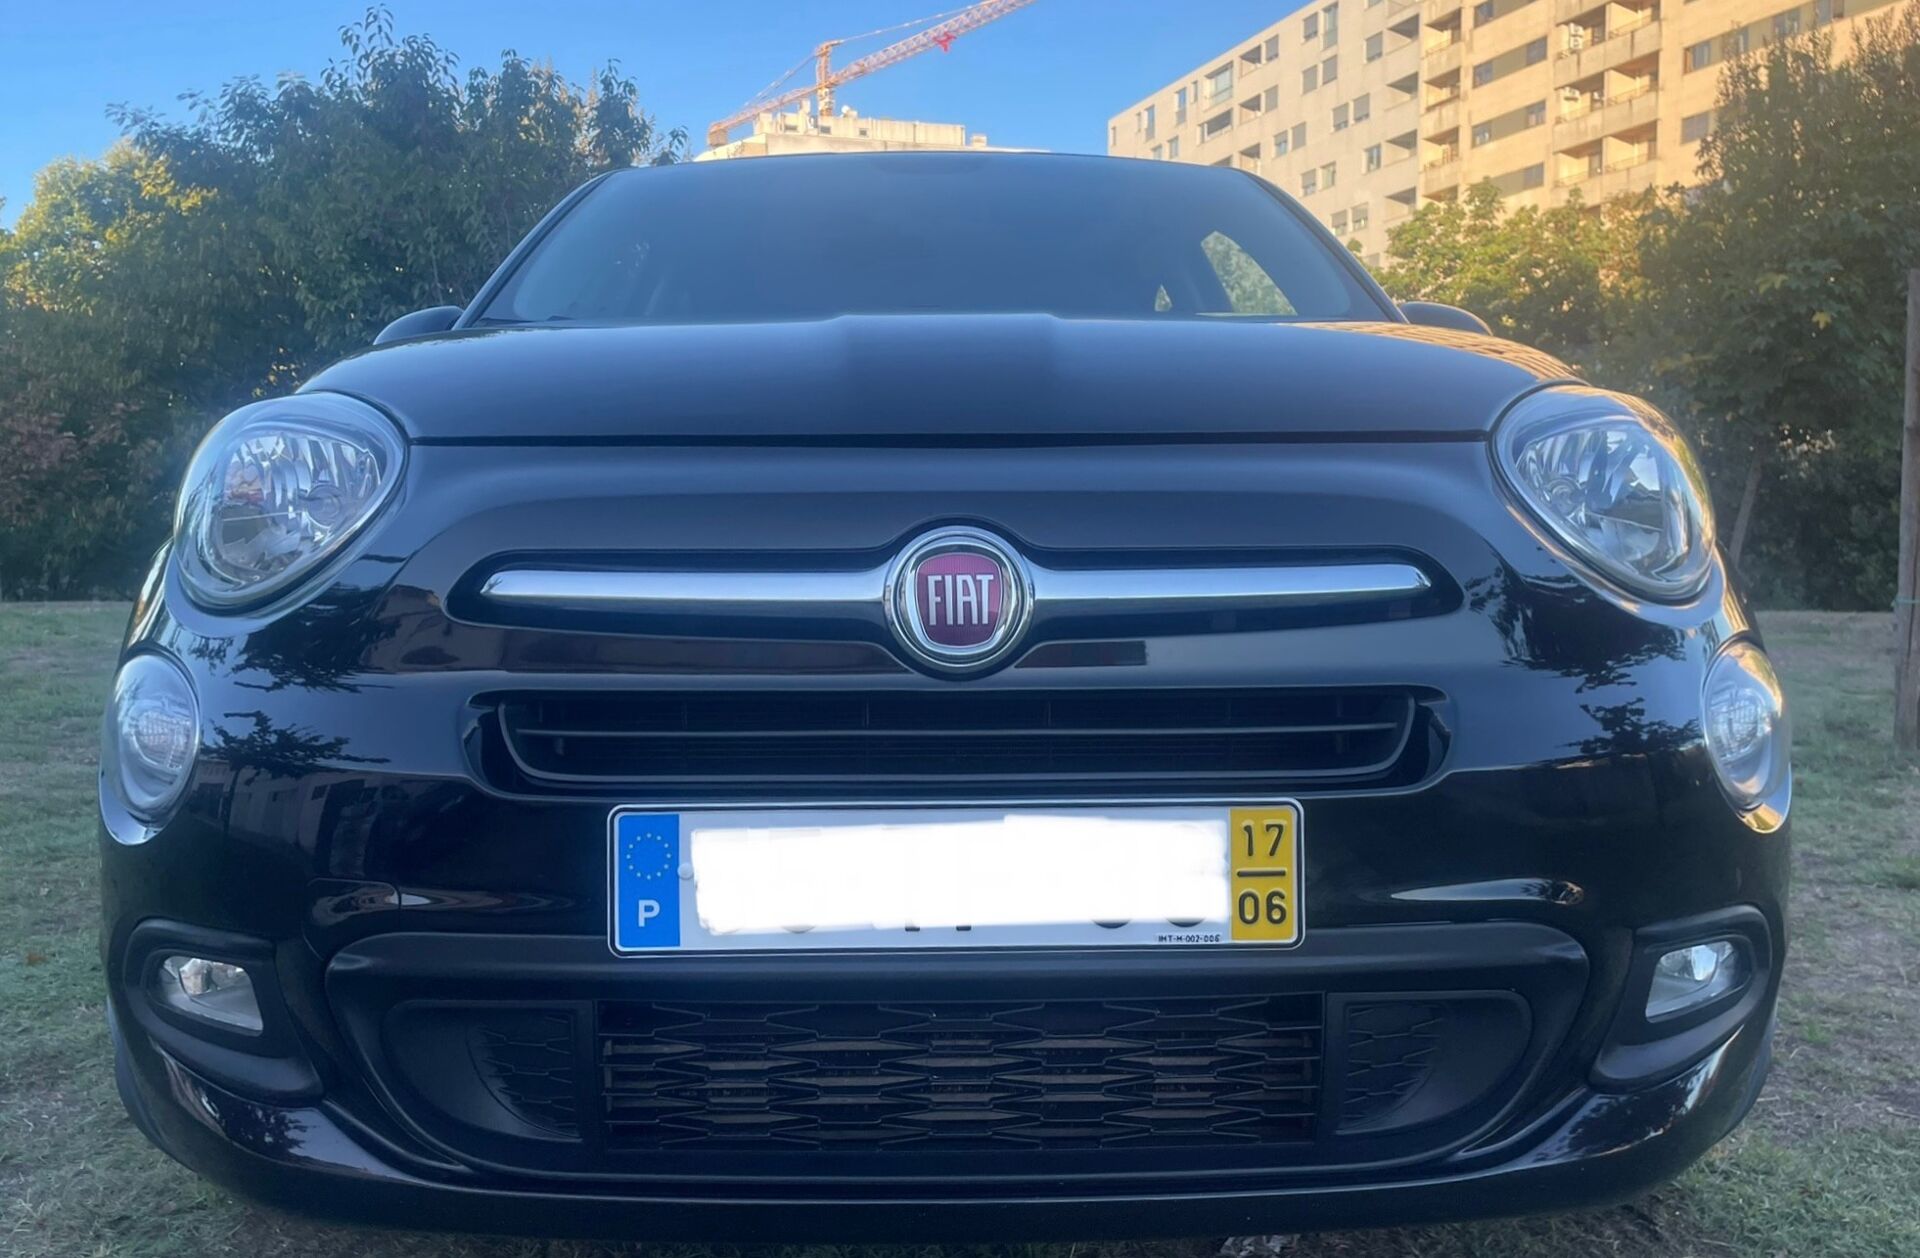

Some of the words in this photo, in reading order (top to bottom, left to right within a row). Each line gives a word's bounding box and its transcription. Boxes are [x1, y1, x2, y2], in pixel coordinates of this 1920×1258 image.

[926, 574, 995, 626] FIAT
[1243, 822, 1285, 857] 17
[637, 899, 661, 928] P
[1238, 889, 1288, 926] 06
